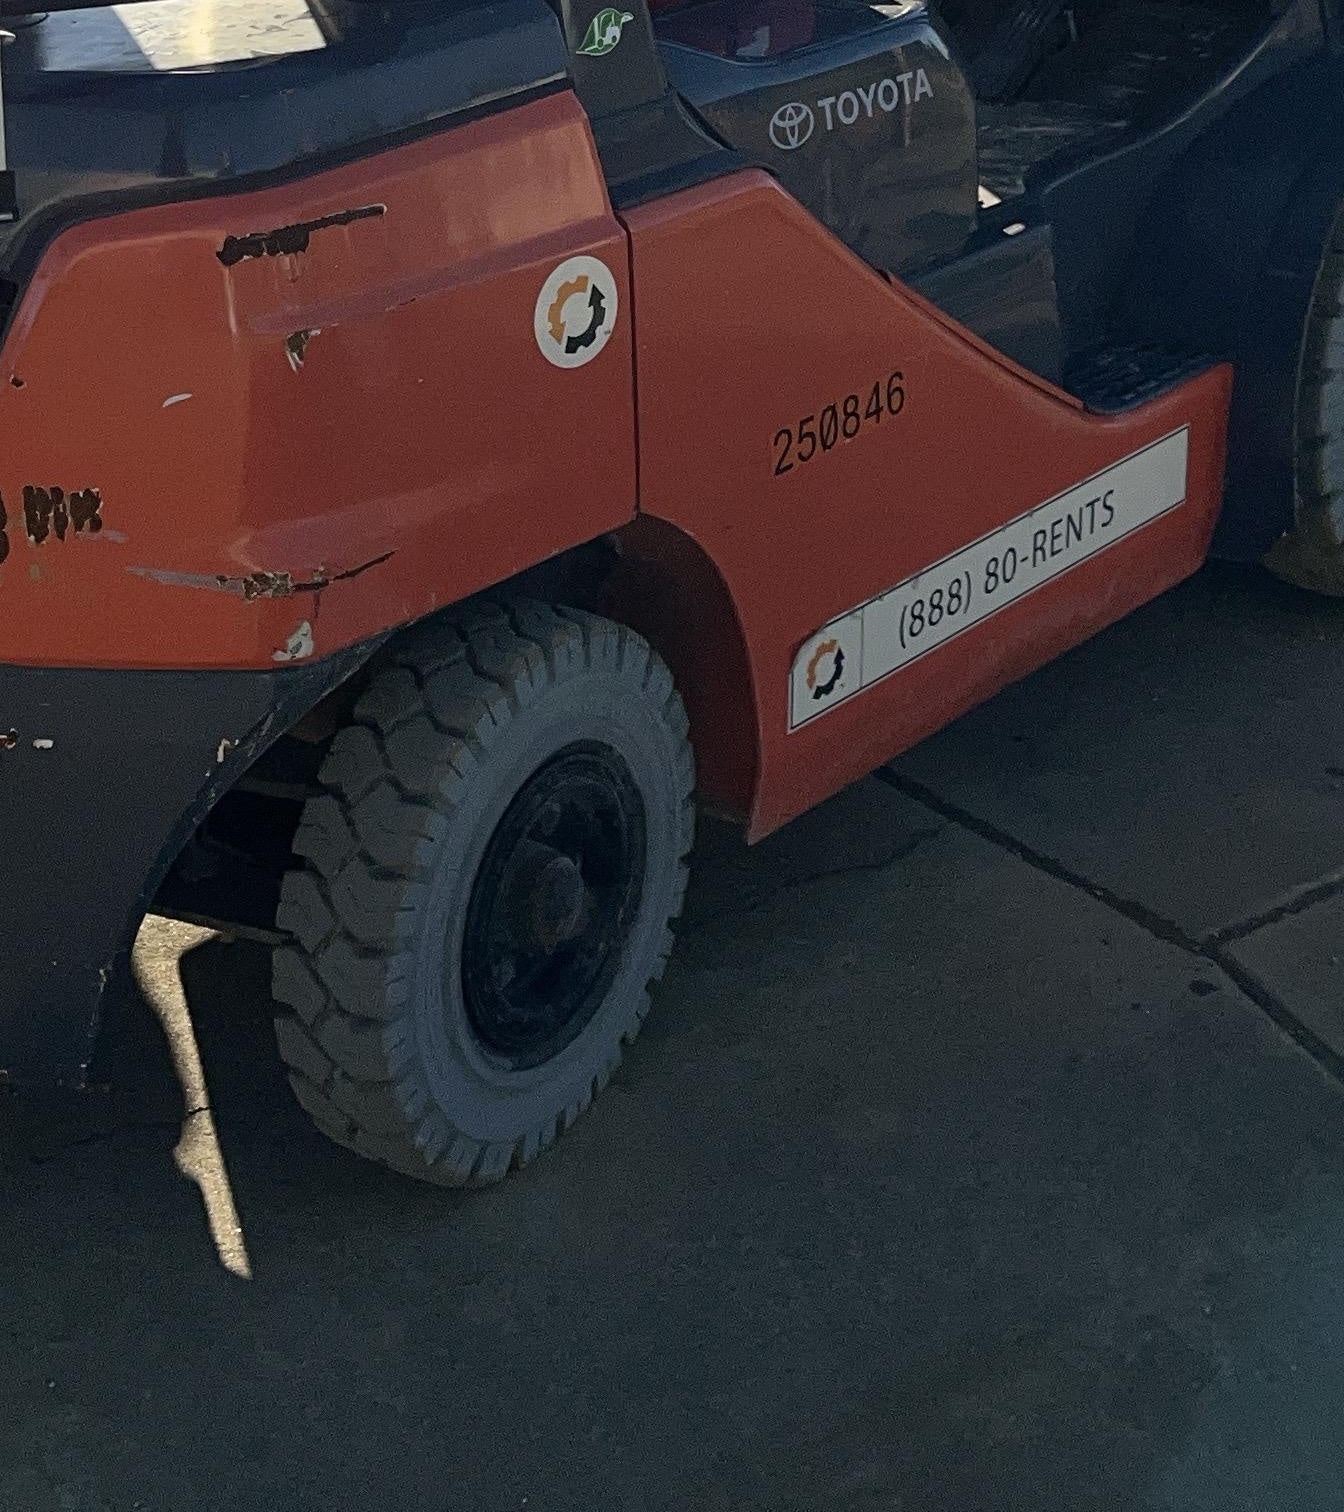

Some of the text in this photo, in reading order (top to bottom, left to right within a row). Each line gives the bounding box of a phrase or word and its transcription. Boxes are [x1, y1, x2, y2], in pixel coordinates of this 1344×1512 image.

[817, 69, 934, 131] TOYOTA
[773, 371, 905, 476] 250846
[899, 489, 1115, 649] (888) 80-RENTS
